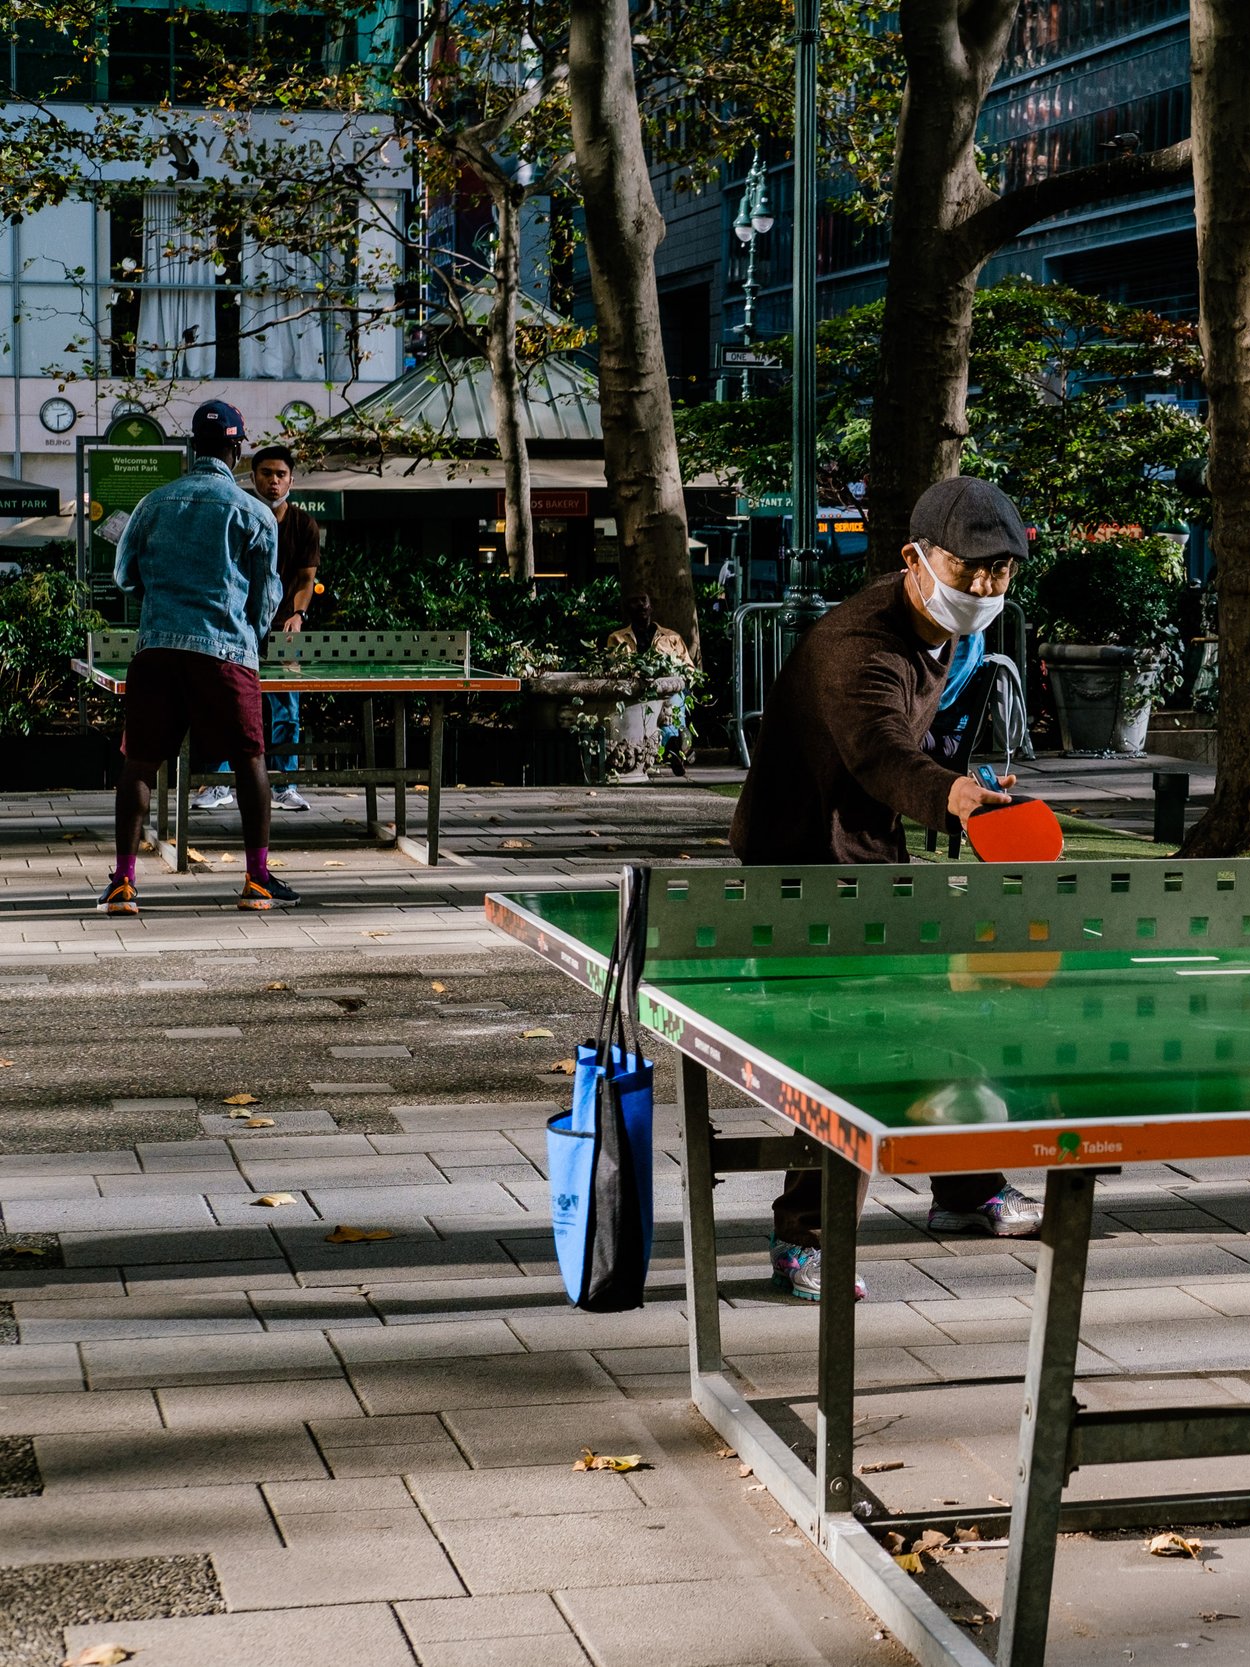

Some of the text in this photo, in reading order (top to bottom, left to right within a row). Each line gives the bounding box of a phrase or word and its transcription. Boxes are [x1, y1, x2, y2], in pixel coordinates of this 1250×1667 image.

[730, 353, 746, 361] ONE
[112, 457, 148, 465] Welcome
[114, 465, 139, 473] Bryant
[21, 500, 47, 508] PARK
[291, 501, 326, 512] PARK
[545, 500, 579, 509] BAKERY
[818, 522, 865, 533] IN SERVICE
[1032, 1140, 1123, 1156] The Tables
